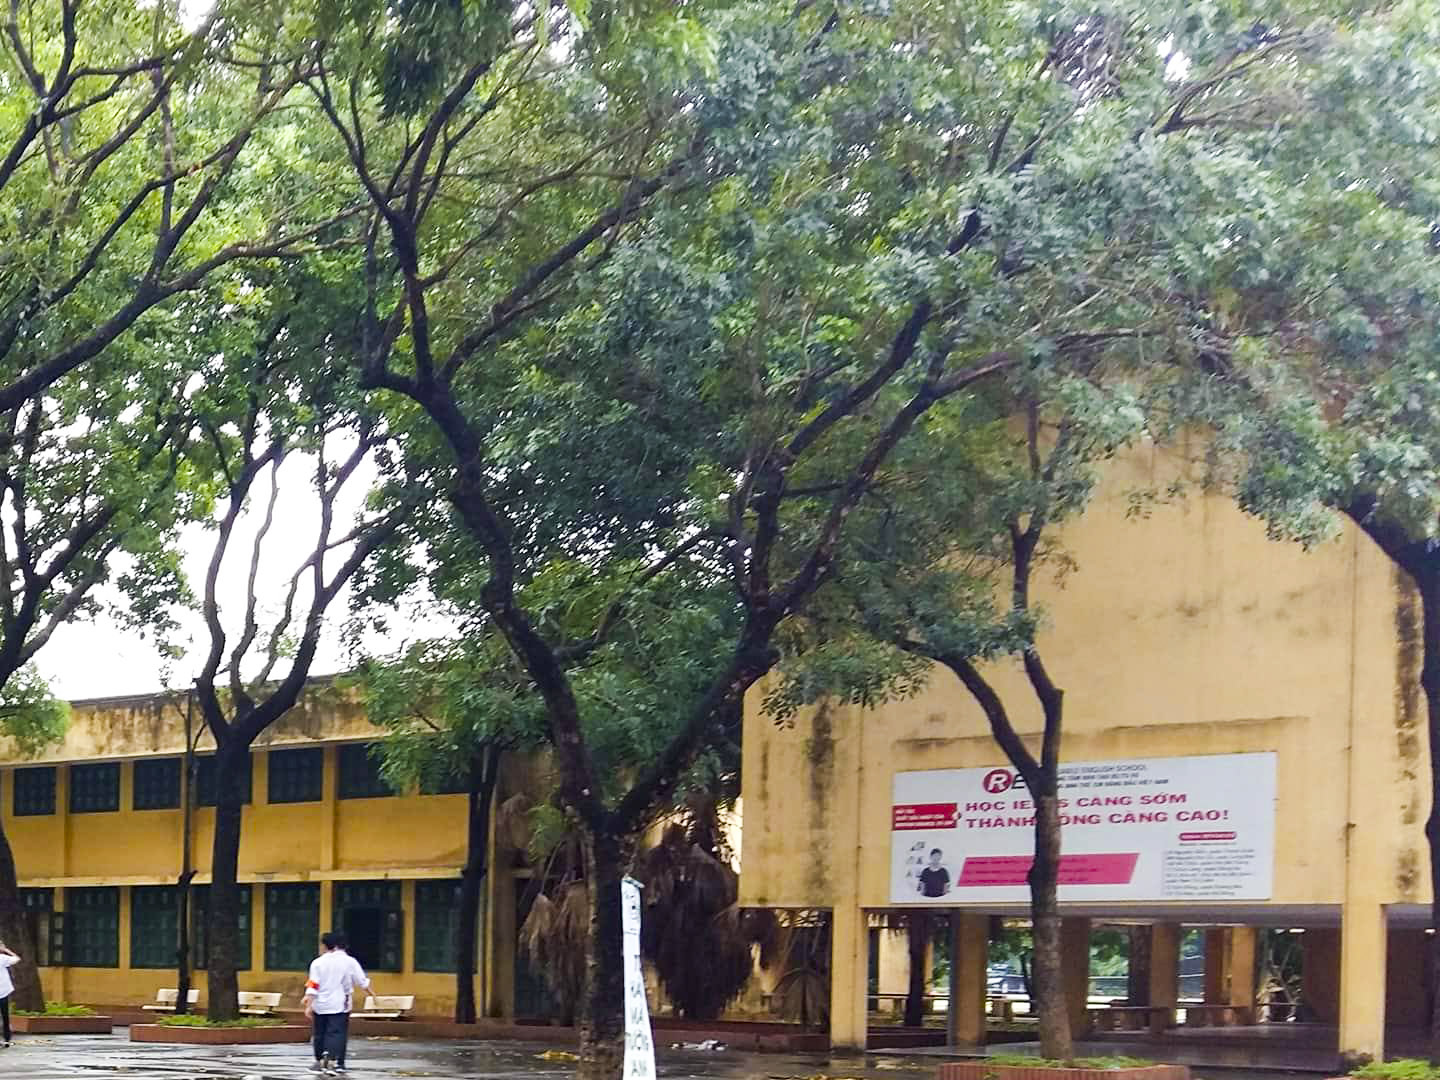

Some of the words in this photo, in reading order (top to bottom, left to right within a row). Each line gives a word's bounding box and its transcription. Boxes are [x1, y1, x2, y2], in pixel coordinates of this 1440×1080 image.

[985, 771, 1026, 792] RE
[1013, 798, 1069, 810] IES
[1176, 810, 1229, 821] CAO!
